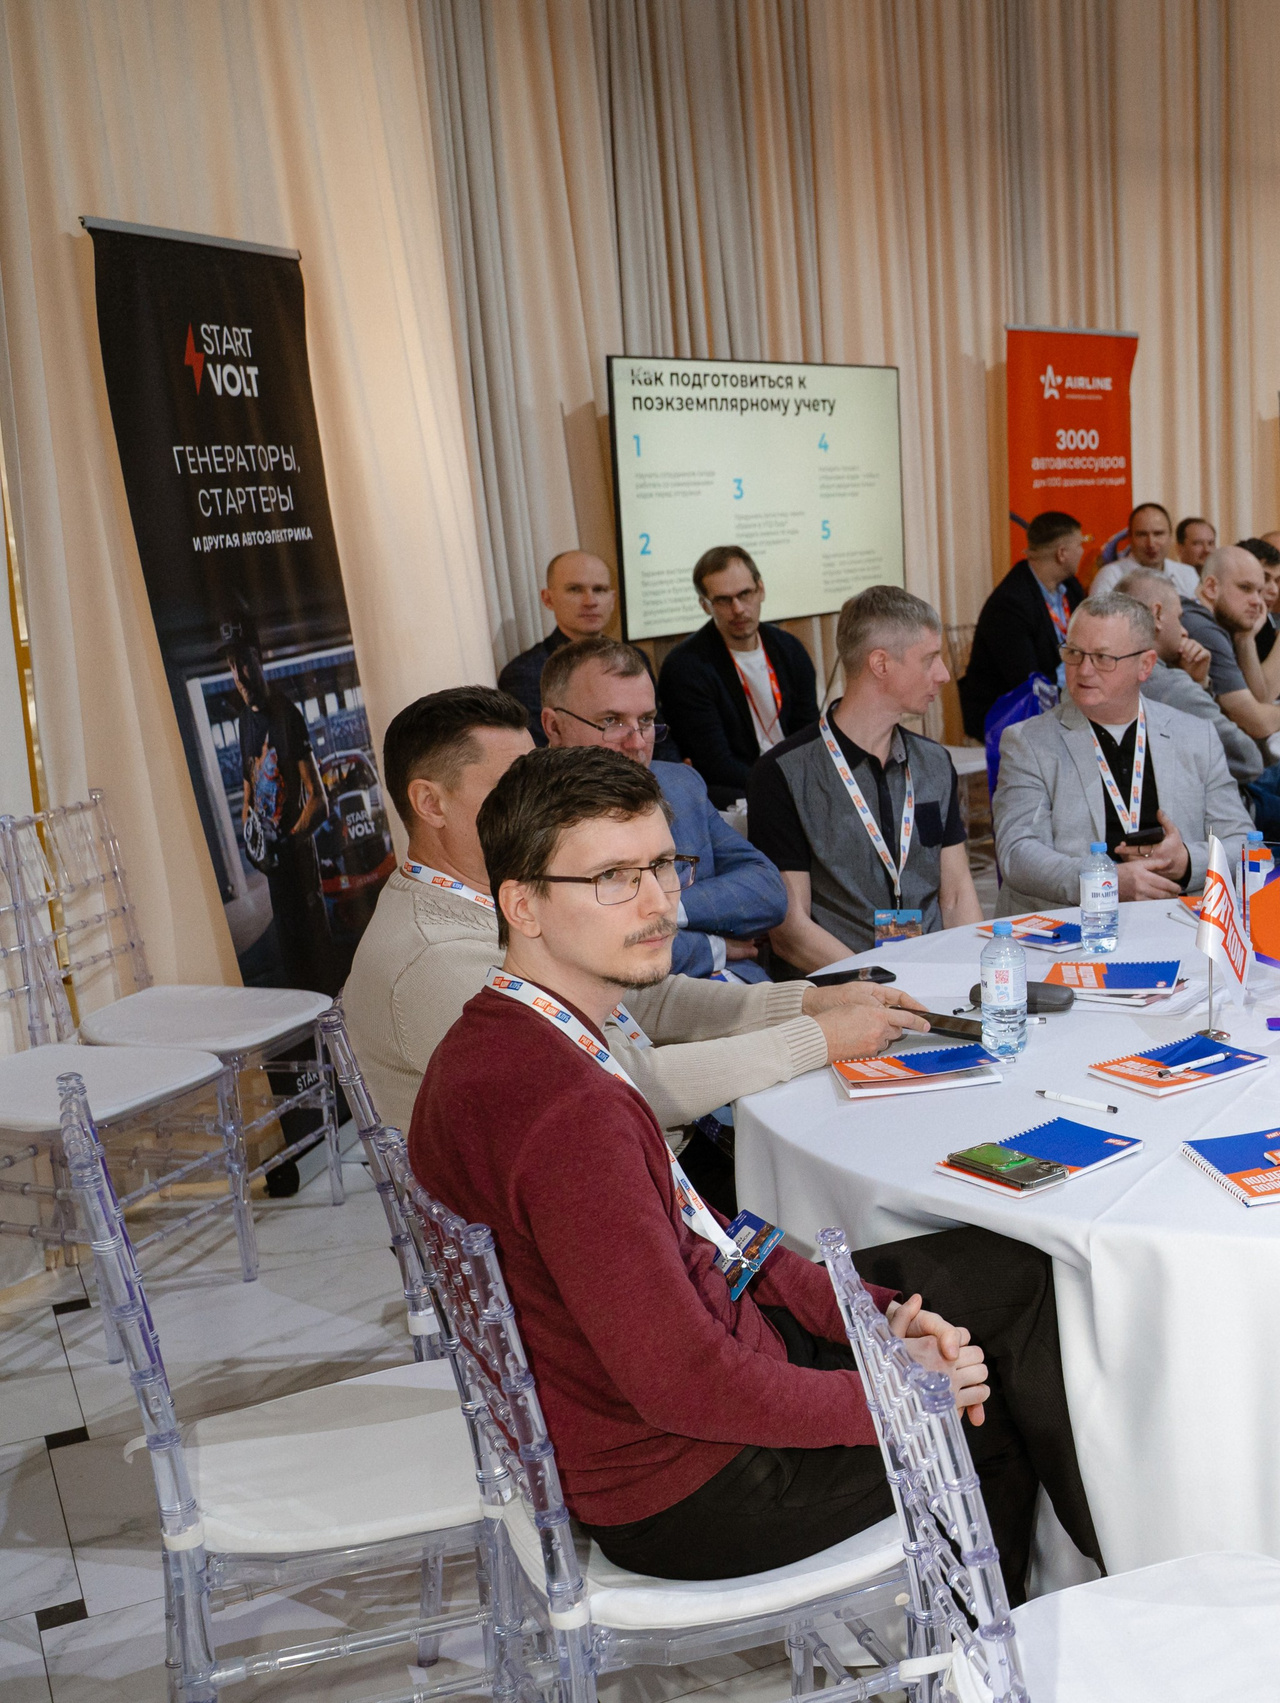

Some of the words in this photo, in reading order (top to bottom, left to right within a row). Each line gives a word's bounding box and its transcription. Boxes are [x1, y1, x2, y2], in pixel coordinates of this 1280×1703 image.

[200, 323, 252, 358] START
[206, 363, 259, 397] VOLT
[631, 369, 663, 386] Как
[670, 372, 793, 390] подготовиться
[798, 376, 806, 389] к
[1065, 376, 1112, 390] AIRLINE
[632, 396, 789, 416] поэкземплярному
[794, 398, 835, 416] учету
[633, 434, 641, 457] 1
[818, 432, 829, 452] 4
[1056, 429, 1099, 450] 3000
[172, 444, 301, 474] ГЕНЕРАТОРЫ,
[1031, 456, 1126, 472] автоаксессуаров
[733, 478, 744, 499] 3
[198, 485, 294, 517] СТАРТЕРЫ
[193, 536, 202, 552] И
[202, 532, 241, 553] ДРУГАЯ
[241, 526, 313, 547] АВТОЭЛЕКТРИКА
[821, 520, 831, 540] 5
[639, 533, 652, 555] 2
[348, 821, 375, 839] VOLT
